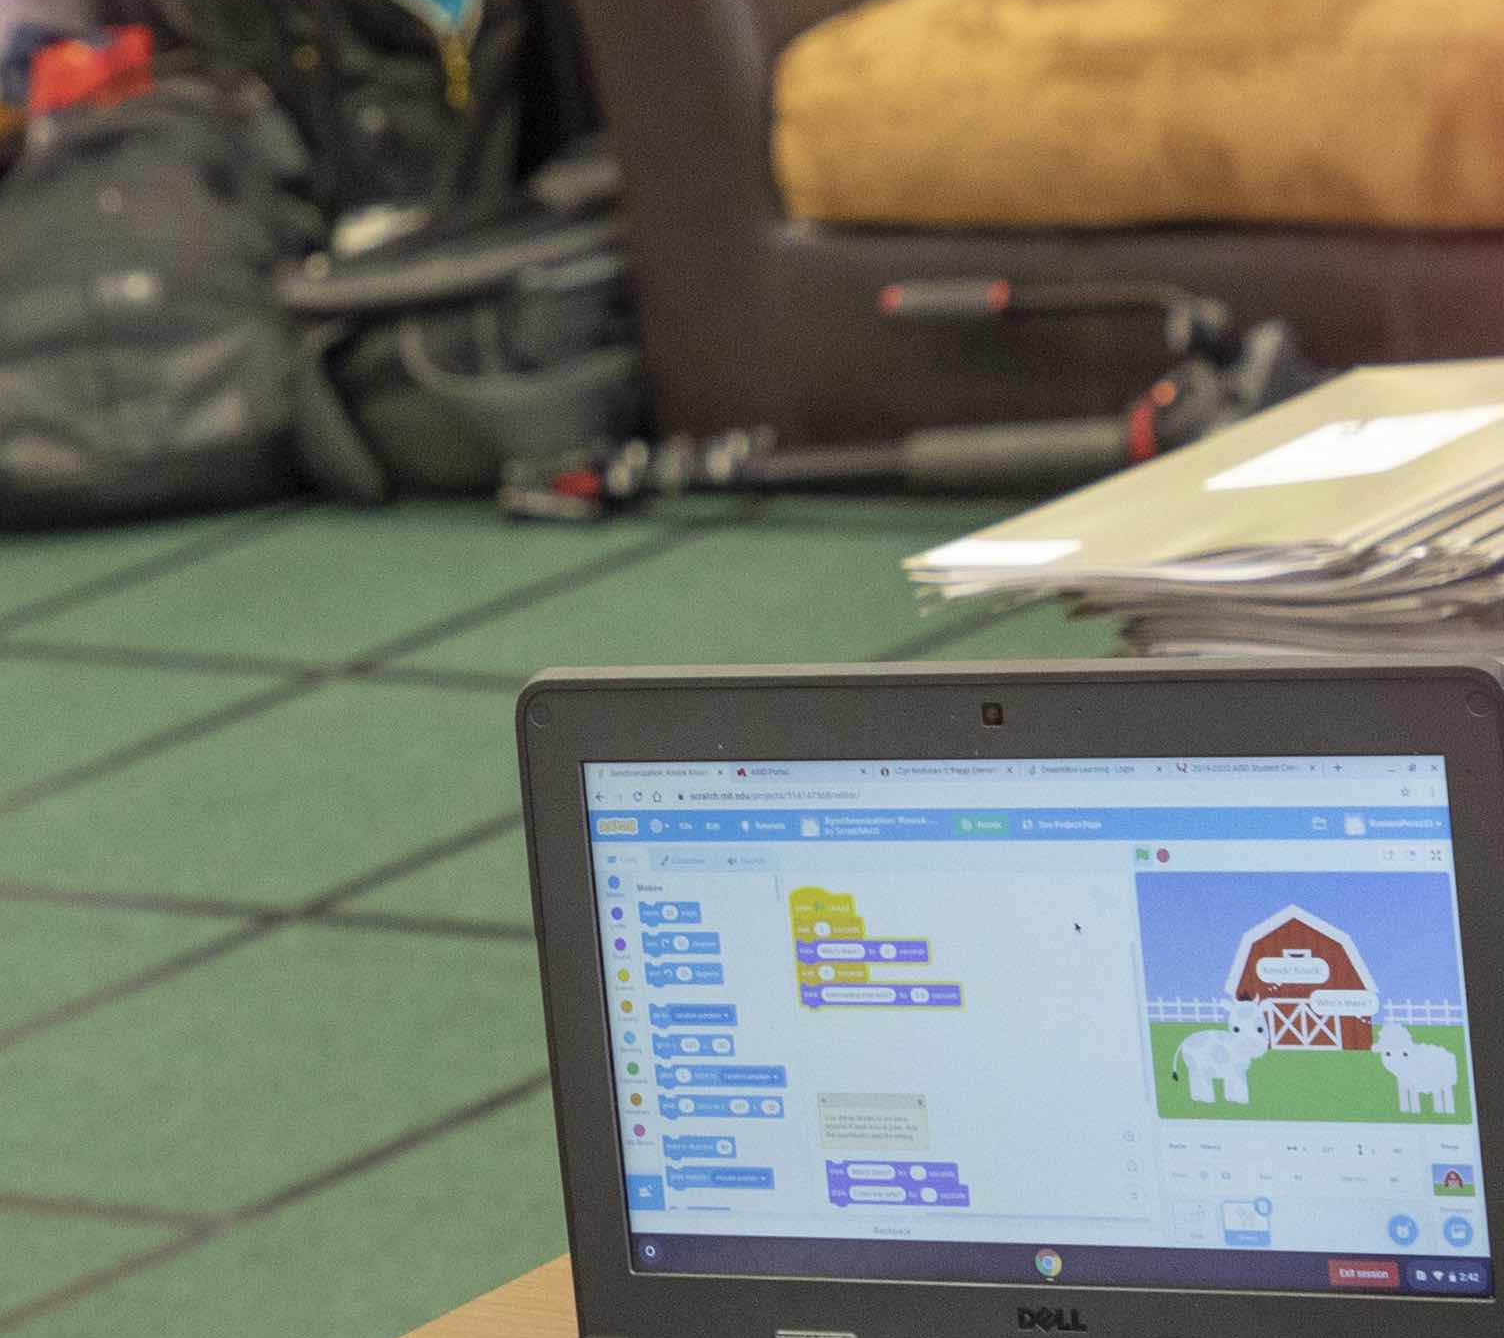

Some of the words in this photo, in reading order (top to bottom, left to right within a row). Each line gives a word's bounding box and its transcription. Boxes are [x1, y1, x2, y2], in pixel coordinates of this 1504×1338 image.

[1339, 1268, 1355, 1278] Exit
[1356, 1269, 1389, 1279] session
[1459, 1271, 1480, 1282] 2:42
[1017, 1307, 1088, 1333] DELL
